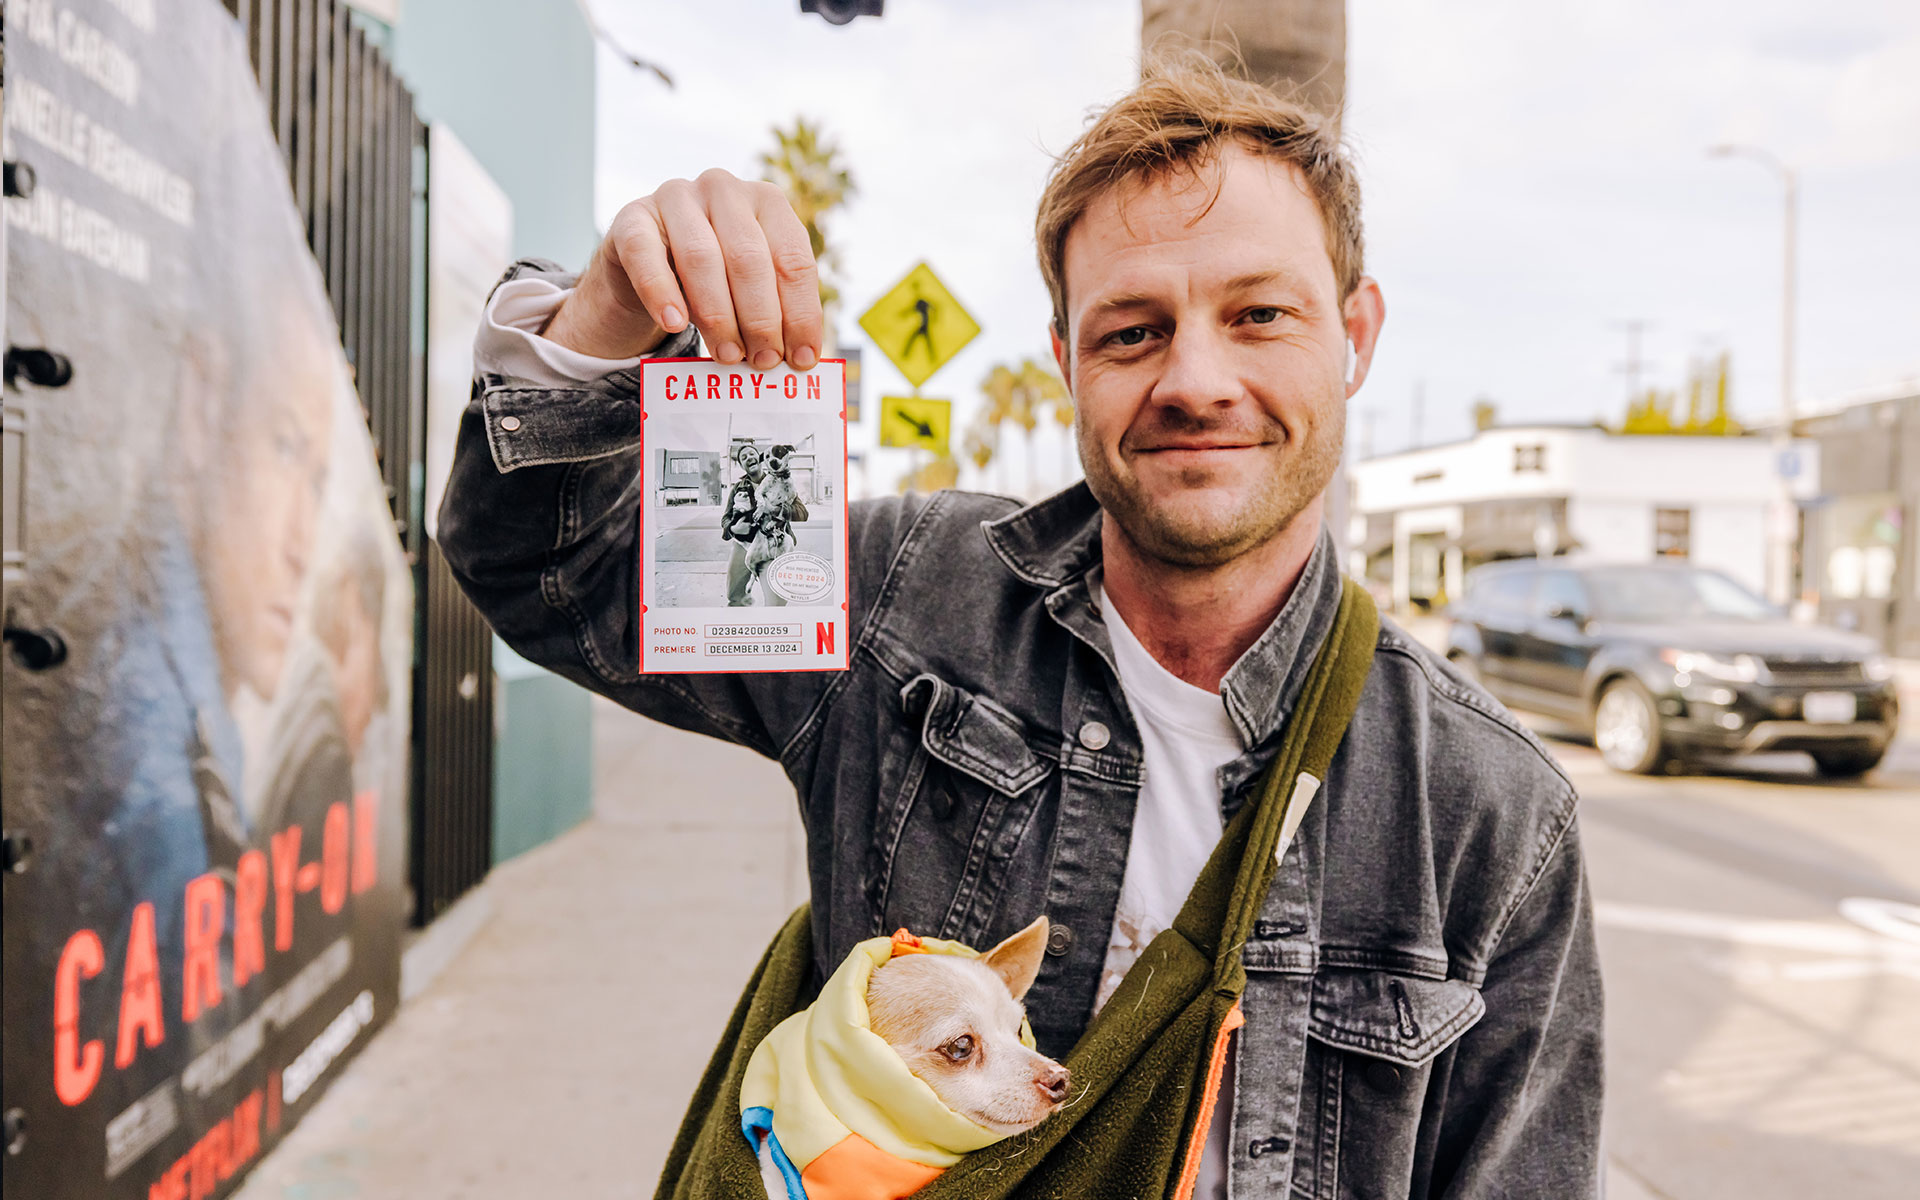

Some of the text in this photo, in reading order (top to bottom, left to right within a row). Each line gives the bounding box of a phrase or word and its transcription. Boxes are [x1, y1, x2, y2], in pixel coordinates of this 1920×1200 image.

[665, 373, 821, 401] CARRY-ON
[653, 626, 789, 636] PHOTO NO. 023842000259
[816, 621, 835, 655] N
[654, 643, 797, 654] PREMIERE DECEMBER 13 2024
[54, 789, 379, 1106] CARRY-ON
